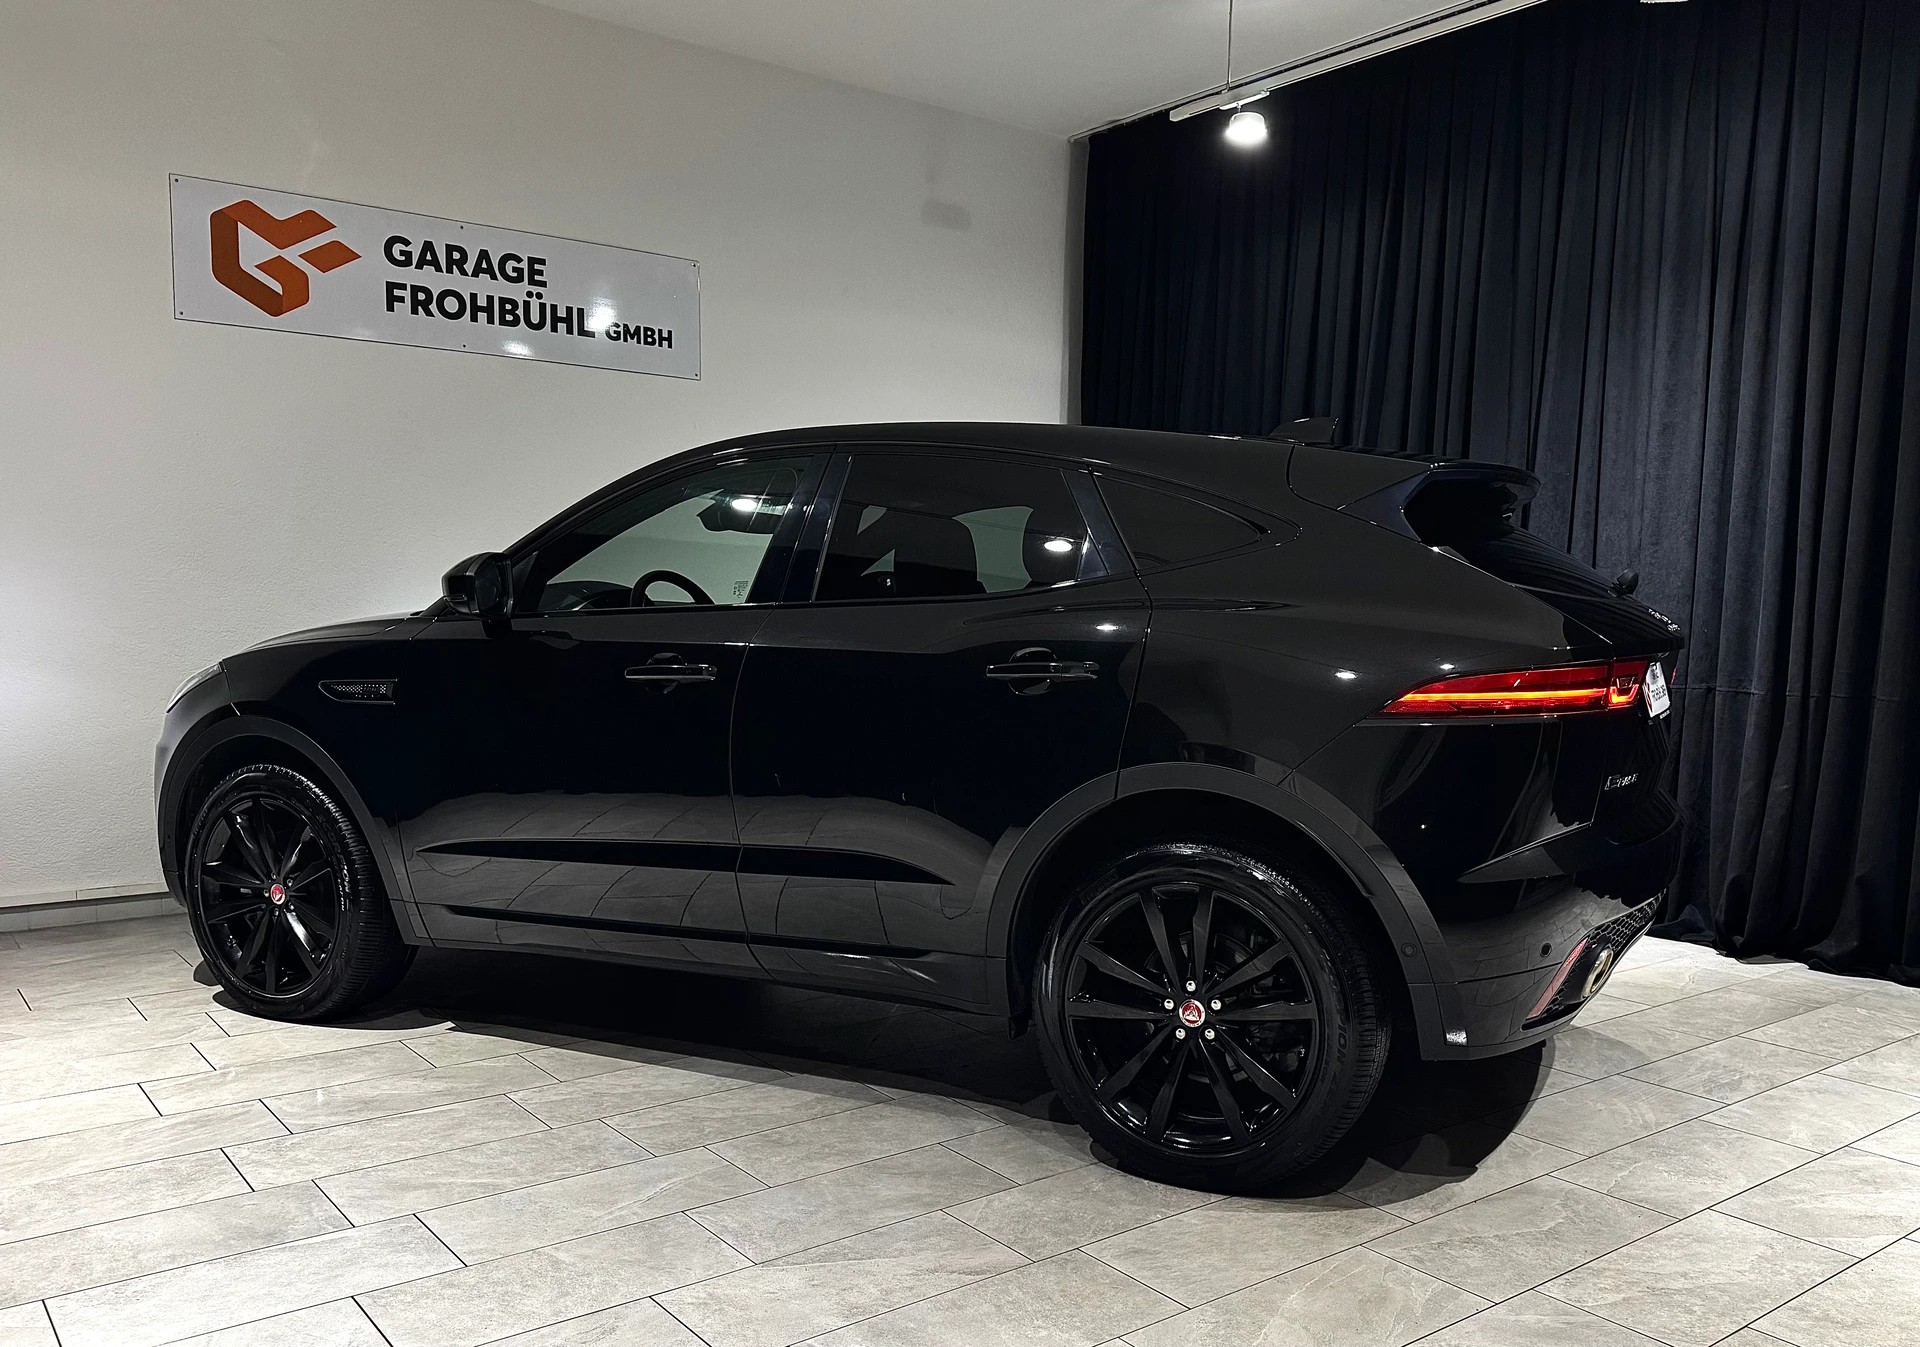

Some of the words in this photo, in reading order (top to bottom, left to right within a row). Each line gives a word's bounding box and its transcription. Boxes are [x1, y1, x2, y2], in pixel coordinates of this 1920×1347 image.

[384, 236, 547, 288] GARAGE
[385, 281, 595, 338] FROHBÜHL
[605, 322, 673, 349] GMBH
